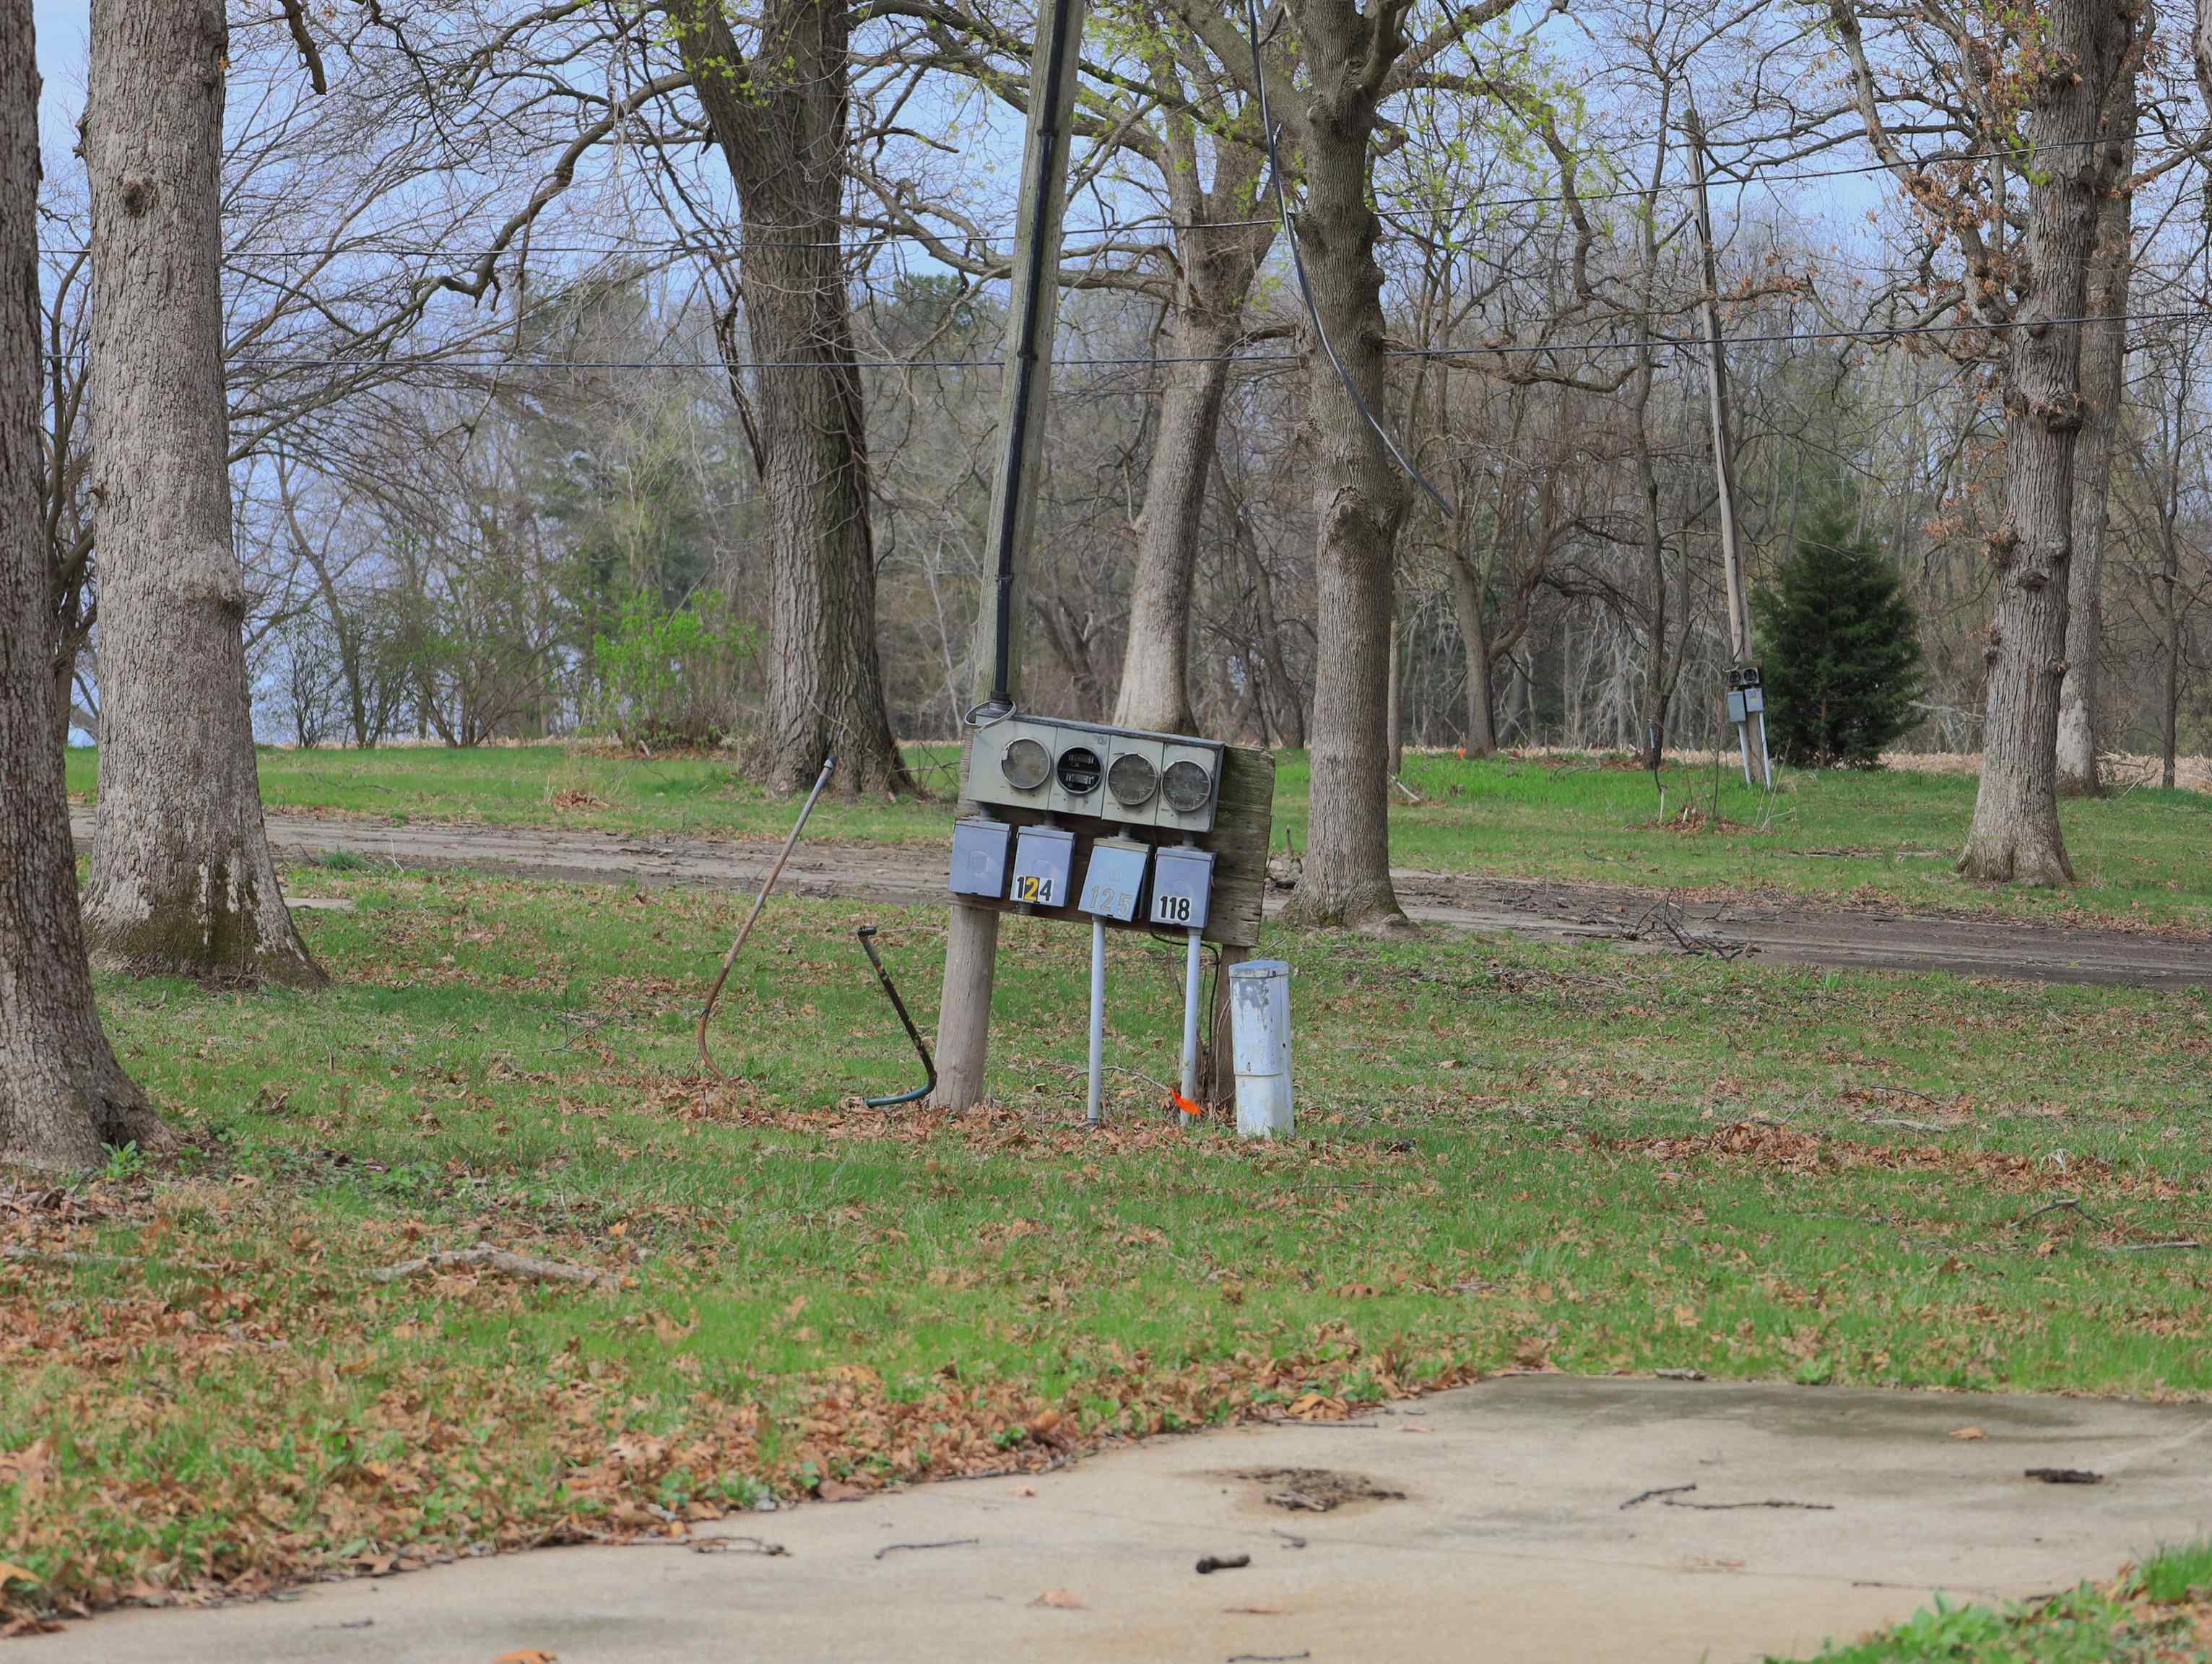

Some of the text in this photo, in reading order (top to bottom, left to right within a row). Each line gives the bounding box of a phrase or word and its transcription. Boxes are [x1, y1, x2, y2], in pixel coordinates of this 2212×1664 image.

[1017, 876, 1052, 902] 124
[1090, 885, 1133, 917] 125
[1160, 896, 1190, 921] 118
